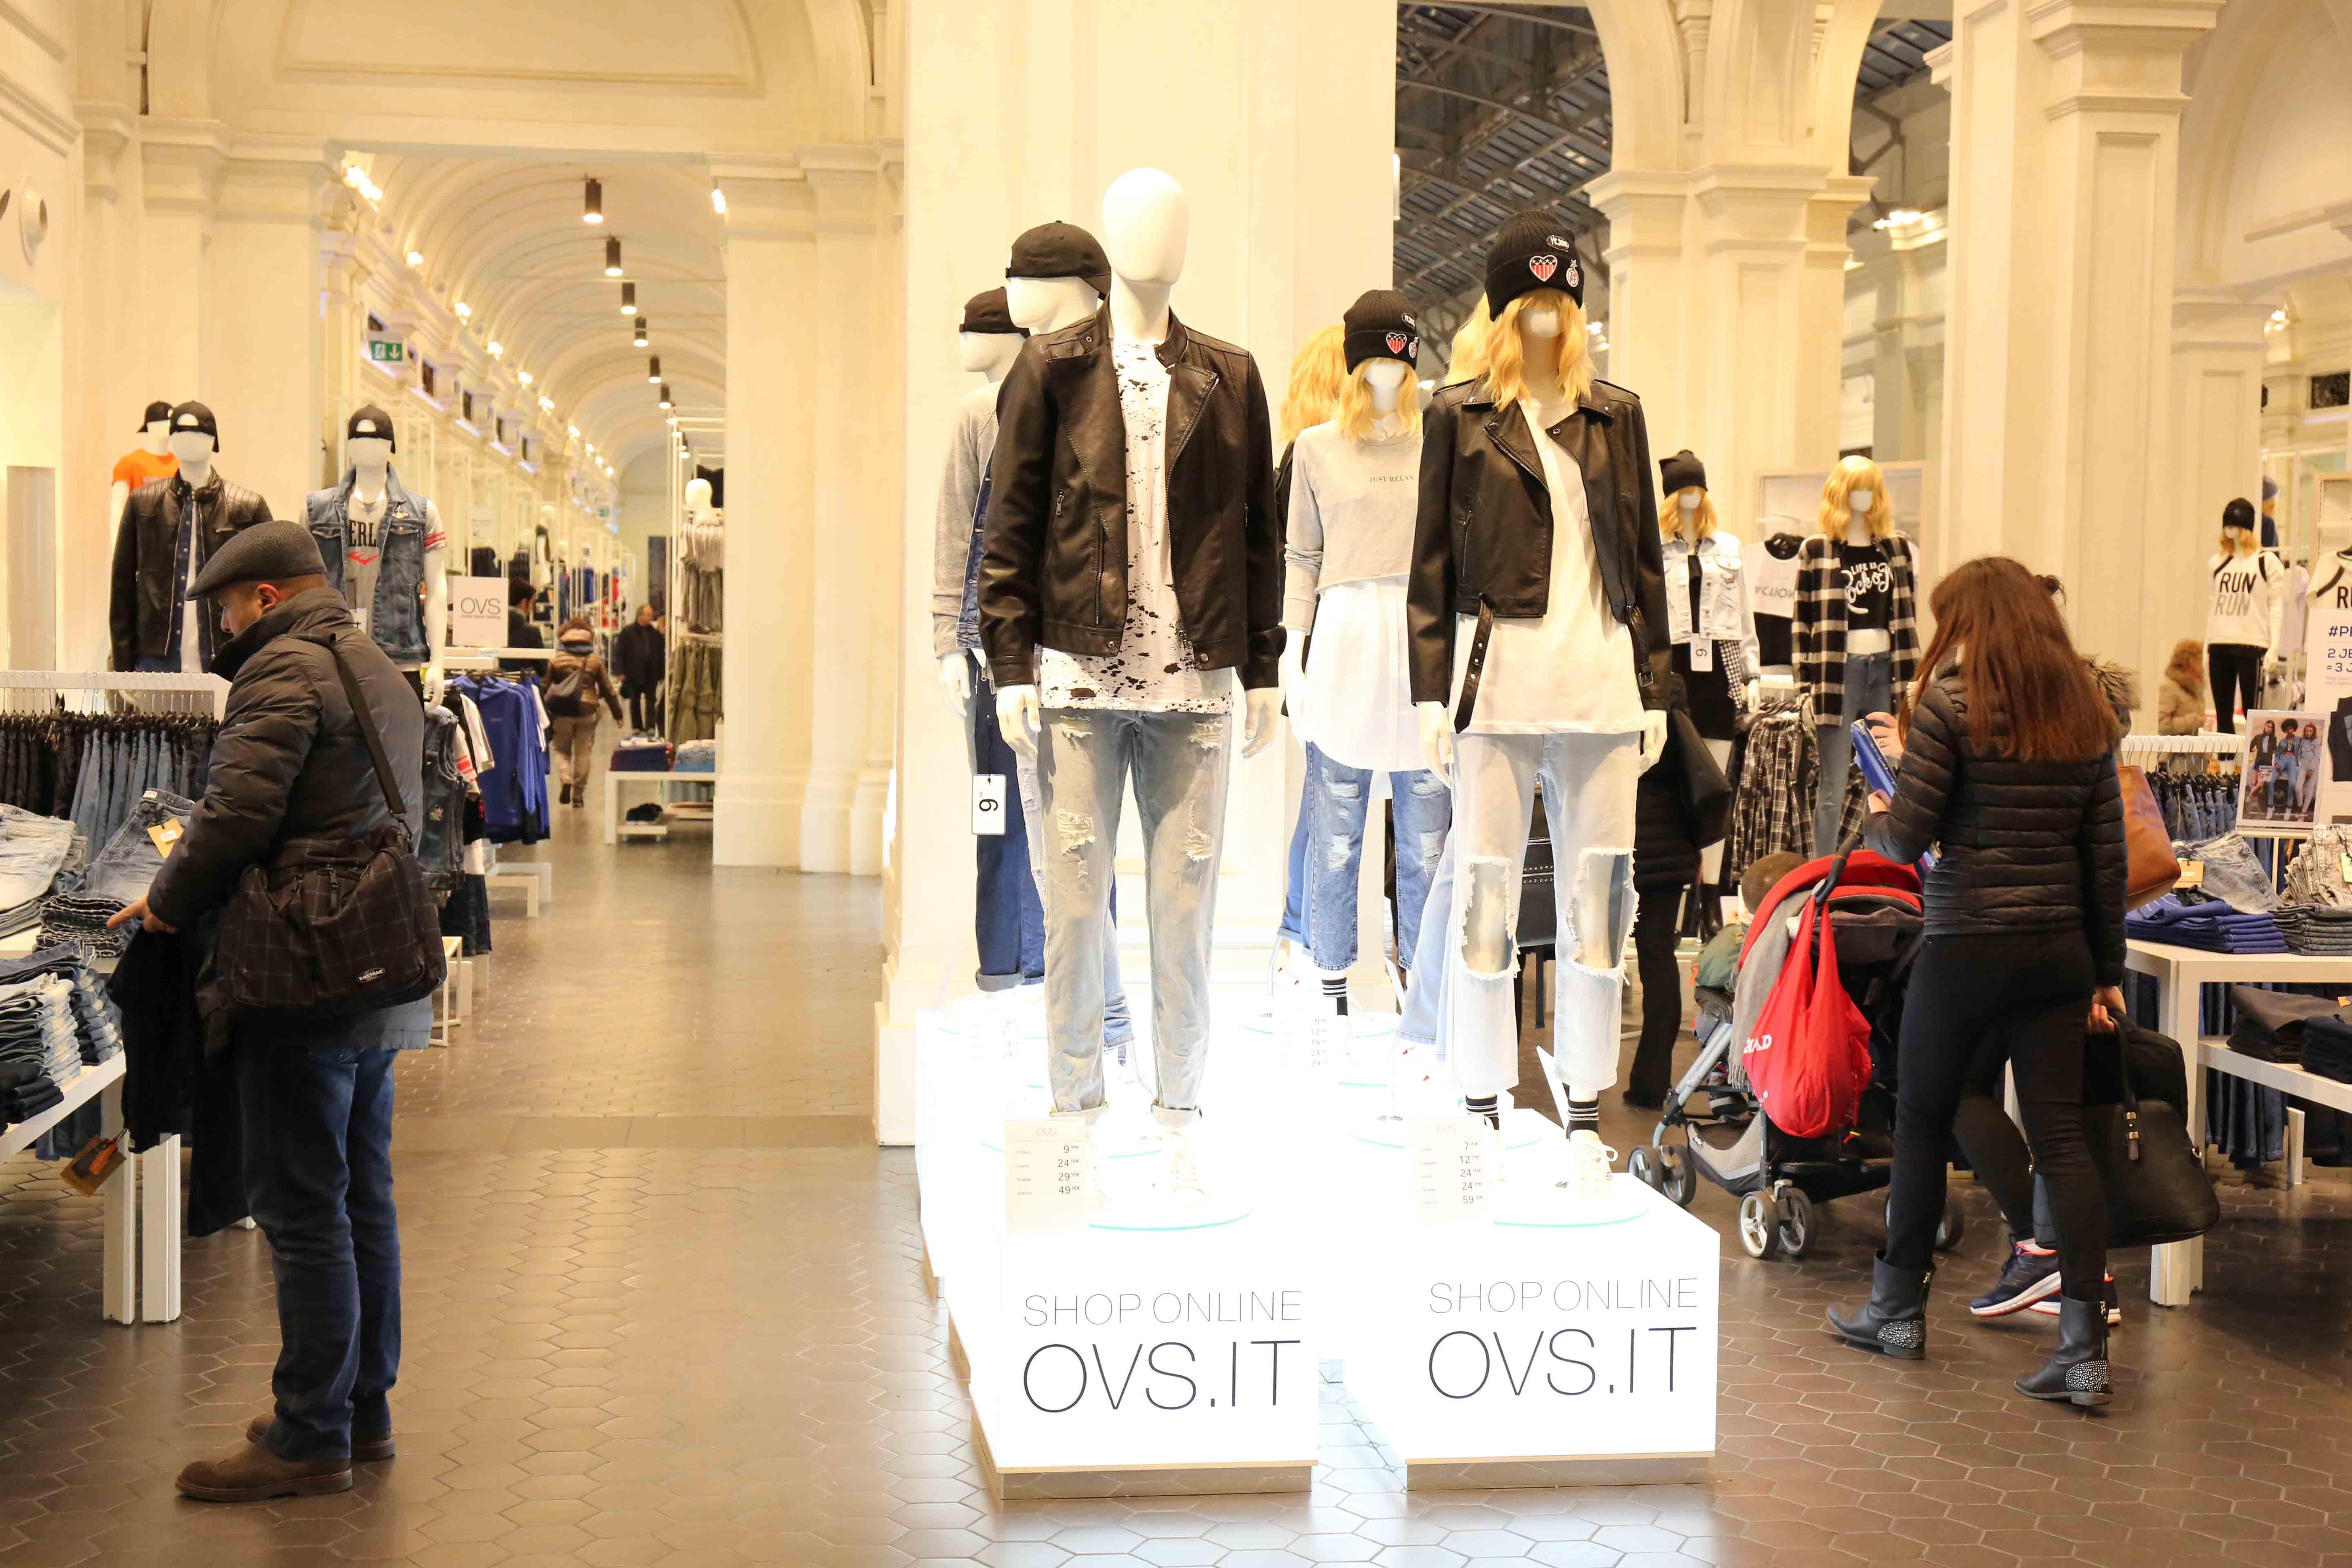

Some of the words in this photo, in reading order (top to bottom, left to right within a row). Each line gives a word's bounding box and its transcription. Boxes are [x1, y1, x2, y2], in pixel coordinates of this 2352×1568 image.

[348, 519, 379, 546] ERL
[1851, 563, 1868, 575] LIFE
[2220, 572, 2256, 594] RUN
[461, 597, 500, 614] OVS
[2215, 595, 2251, 616] RUN
[2328, 648, 2336, 658] 2
[2335, 662, 2343, 672] 3
[359, 969, 383, 980] EASTPAK
[1036, 1128, 1057, 1137] OVS
[1063, 1145, 1069, 1154] 9
[1464, 1142, 1469, 1150] 7
[1058, 1159, 1069, 1167] 24
[1459, 1156, 1470, 1164] 12
[1058, 1172, 1070, 1181] 29
[1460, 1169, 1471, 1177] 24
[1059, 1186, 1071, 1194] 49
[1462, 1182, 1472, 1190] 24
[1463, 1196, 1474, 1204] 59
[1430, 1281, 1542, 1314] SHOP
[1554, 1278, 1698, 1311] ONLINE
[1024, 1294, 1141, 1326] SHOP
[1153, 1291, 1302, 1323] ONLINE
[1429, 1326, 1697, 1399] OVS.IT
[1023, 1340, 1301, 1413] OVS.IT
